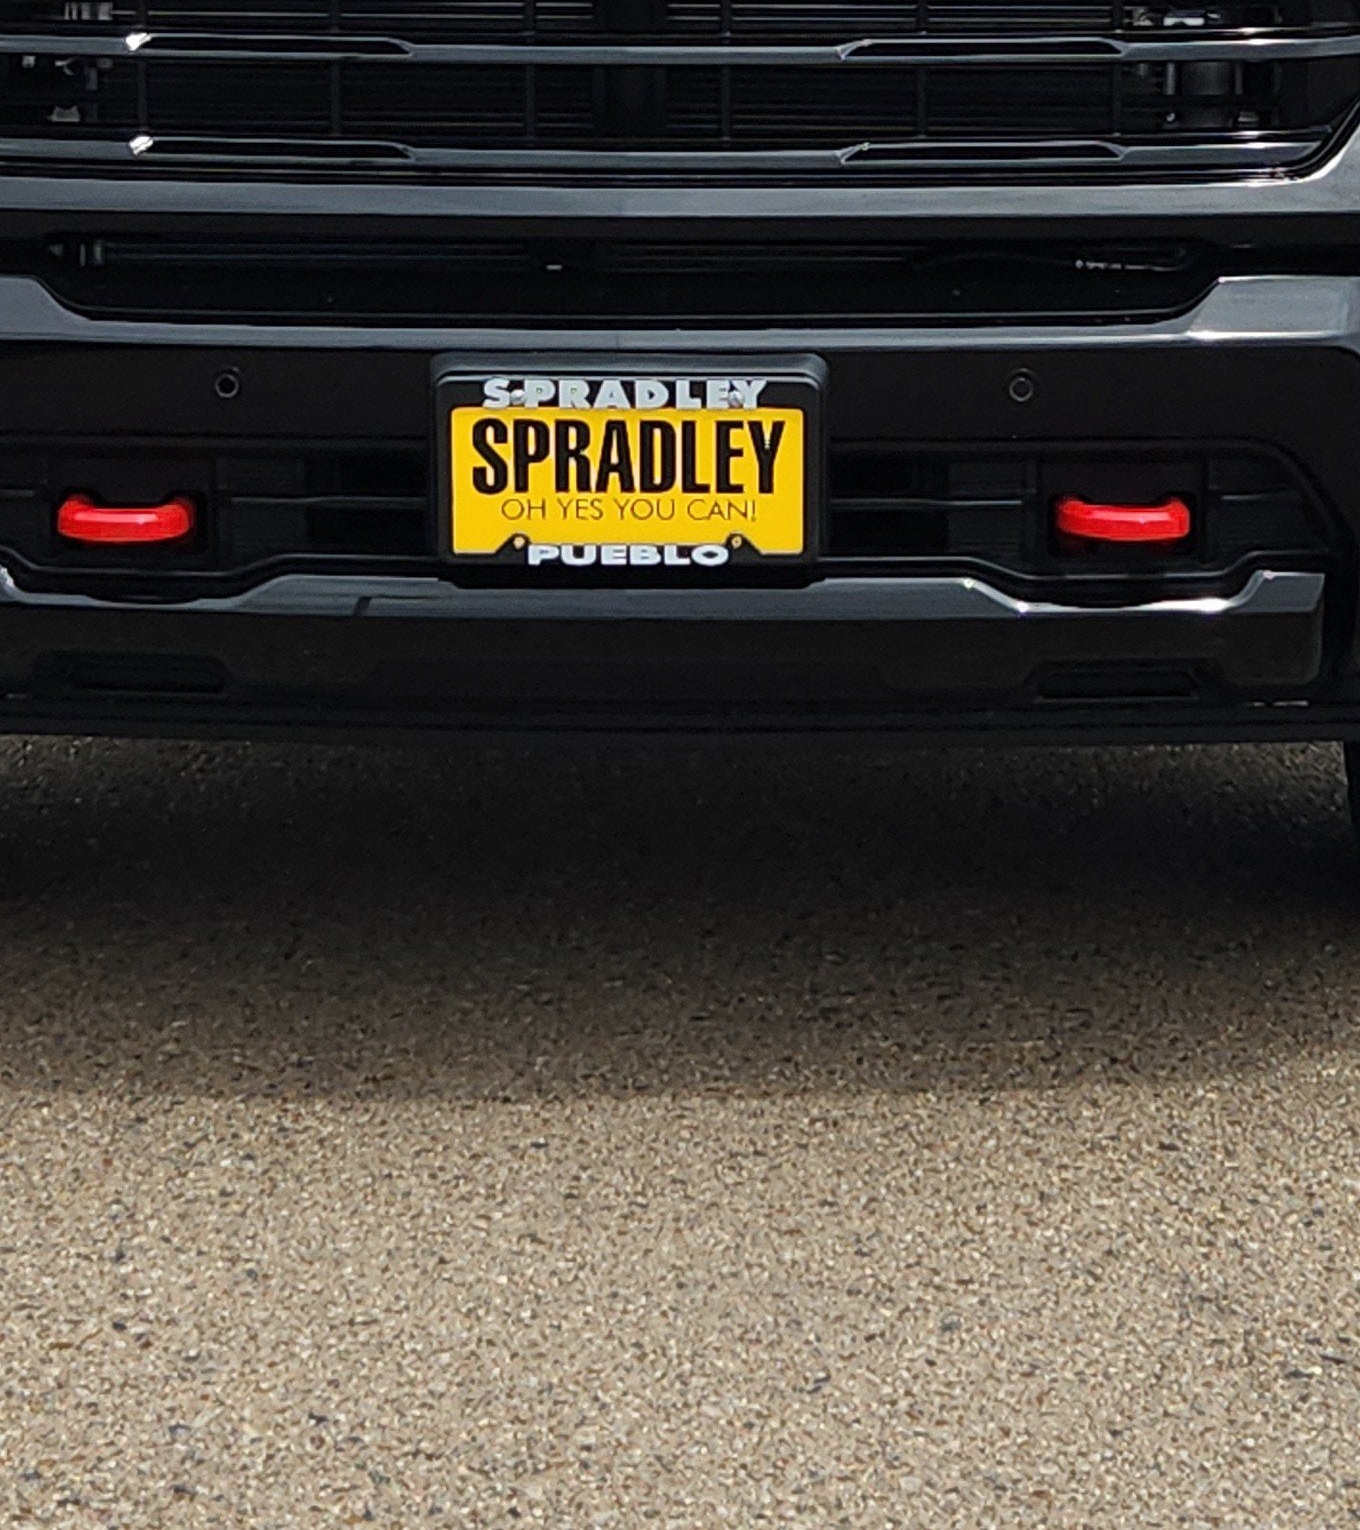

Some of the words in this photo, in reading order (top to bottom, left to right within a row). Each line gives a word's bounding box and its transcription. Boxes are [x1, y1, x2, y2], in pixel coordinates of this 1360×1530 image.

[482, 376, 767, 409] SPRADLEY
[472, 417, 786, 495] SPRADLEY
[501, 498, 547, 520] OH
[556, 498, 604, 520] YES
[612, 498, 676, 520] YOU
[686, 498, 757, 522] CAN!
[527, 544, 730, 566] PUEBLO
